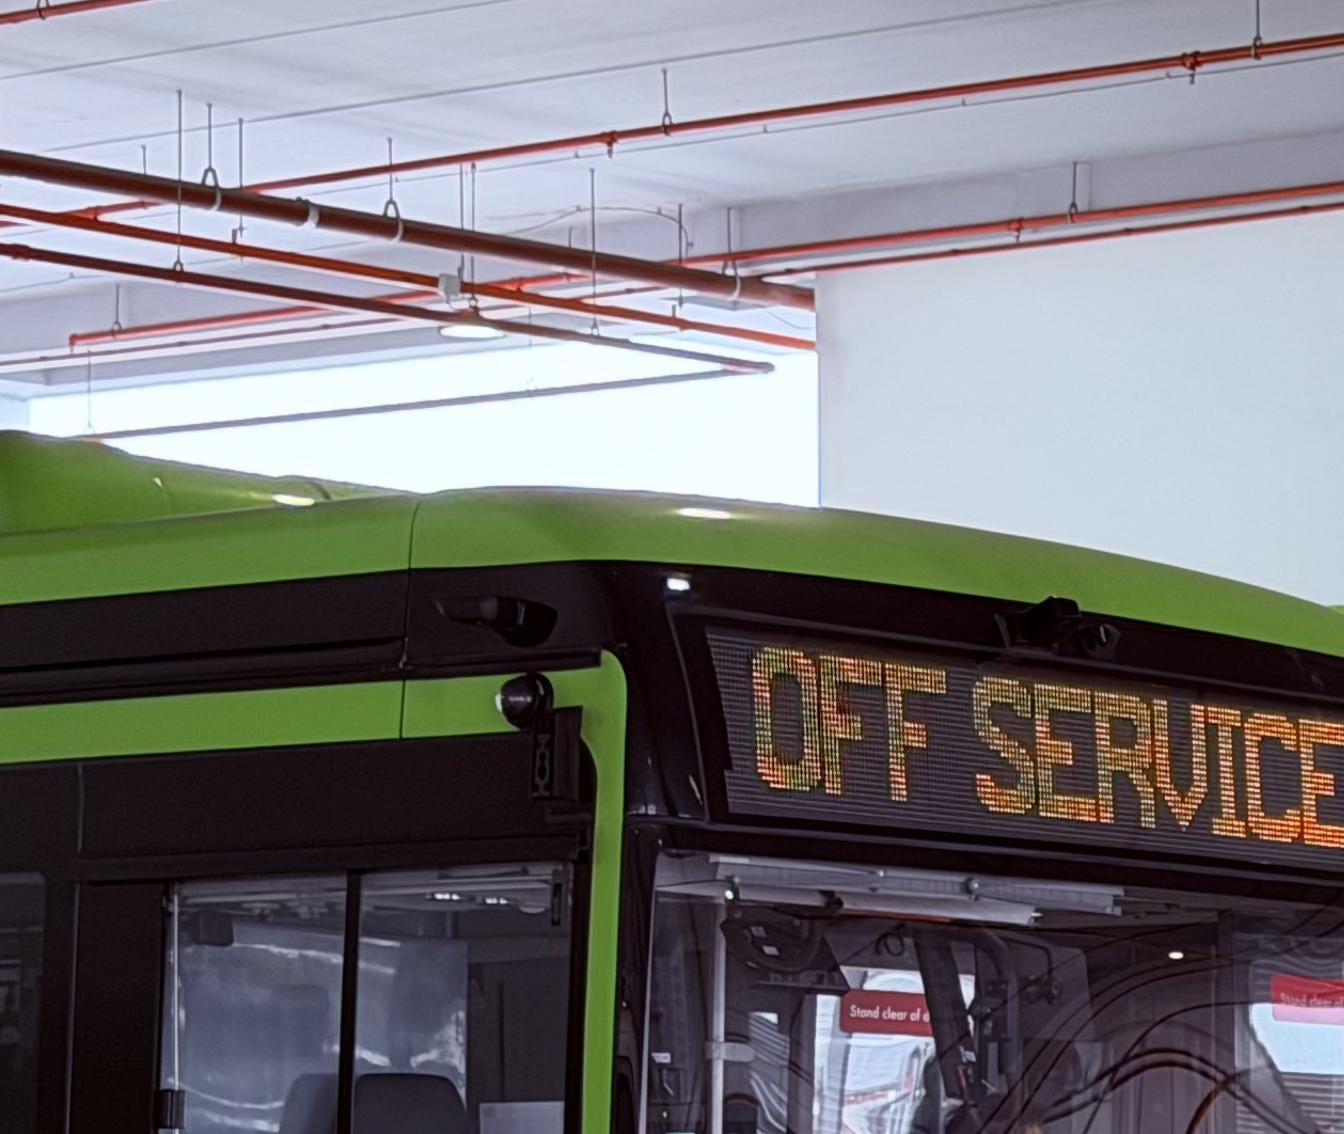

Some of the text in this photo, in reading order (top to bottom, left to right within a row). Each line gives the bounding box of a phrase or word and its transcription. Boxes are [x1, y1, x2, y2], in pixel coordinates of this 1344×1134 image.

[752, 646, 947, 802] OFF
[850, 1005, 879, 1019] Stand
[882, 1007, 907, 1021] clear
[910, 1008, 920, 1022] of
